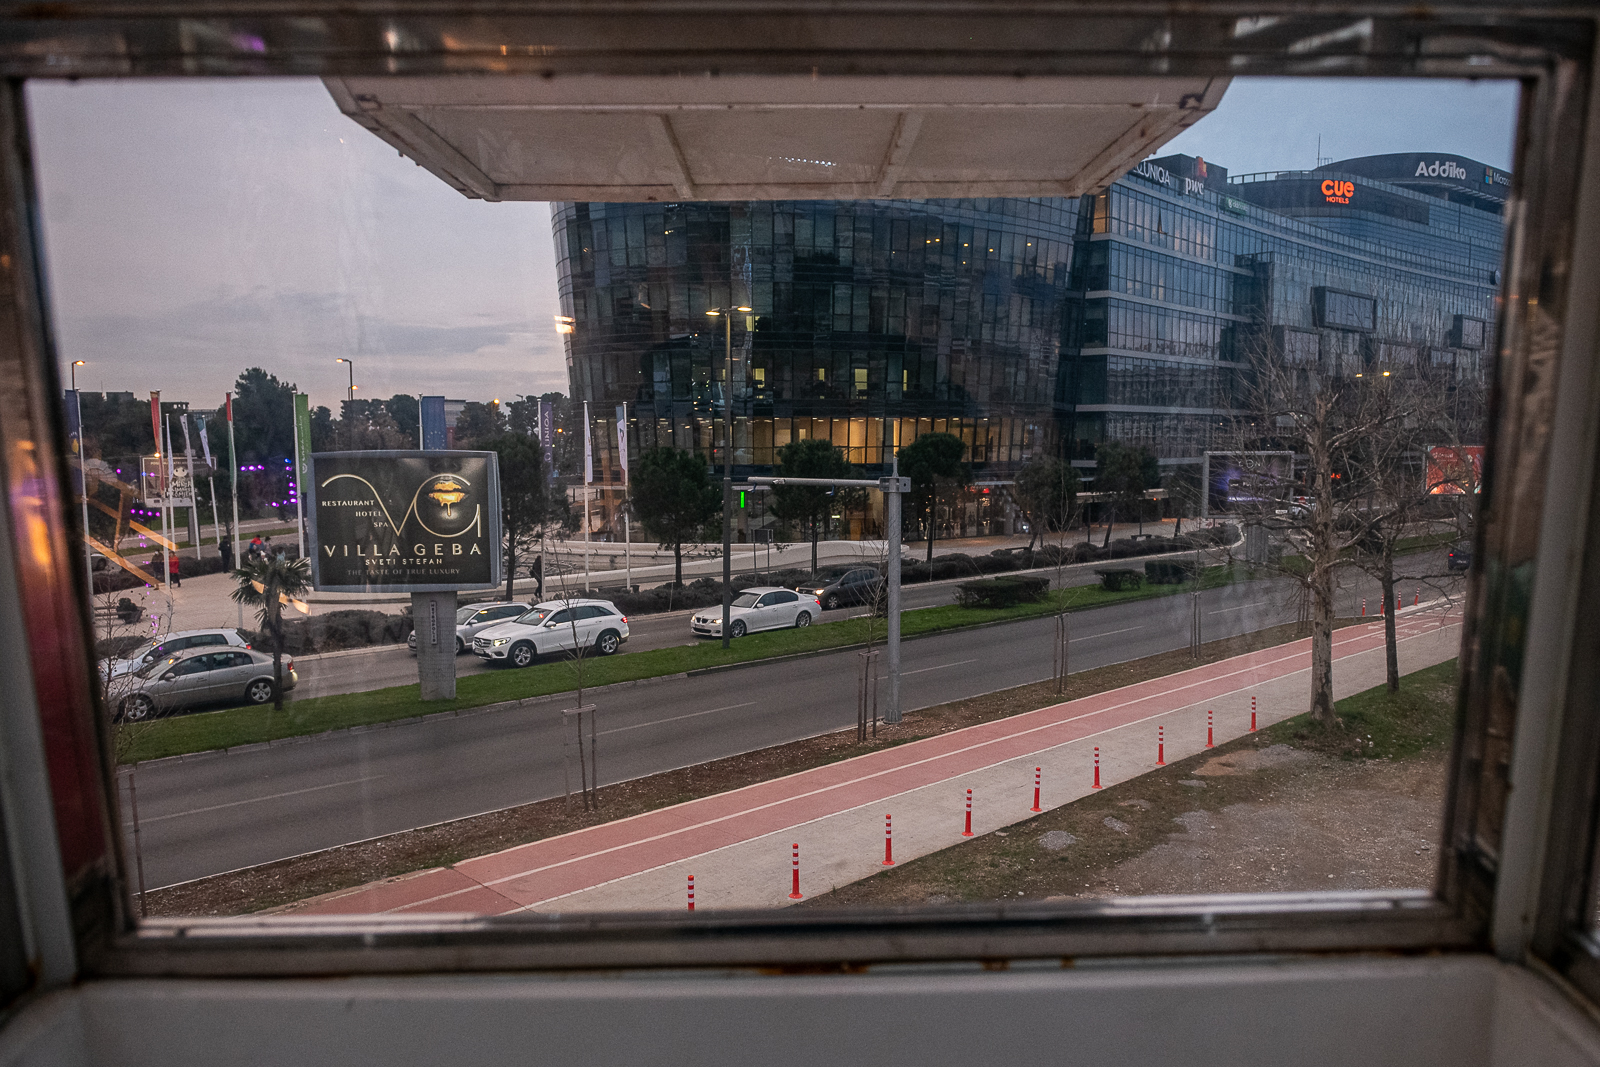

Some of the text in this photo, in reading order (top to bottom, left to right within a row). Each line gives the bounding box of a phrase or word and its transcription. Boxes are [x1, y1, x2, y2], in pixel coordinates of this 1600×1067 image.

[1143, 160, 1170, 186] UNIQA
[1415, 161, 1467, 180] Addiko
[1185, 177, 1204, 195] pwc
[1326, 196, 1350, 205] HOTELS
[324, 543, 482, 558] VILLA GEBA
